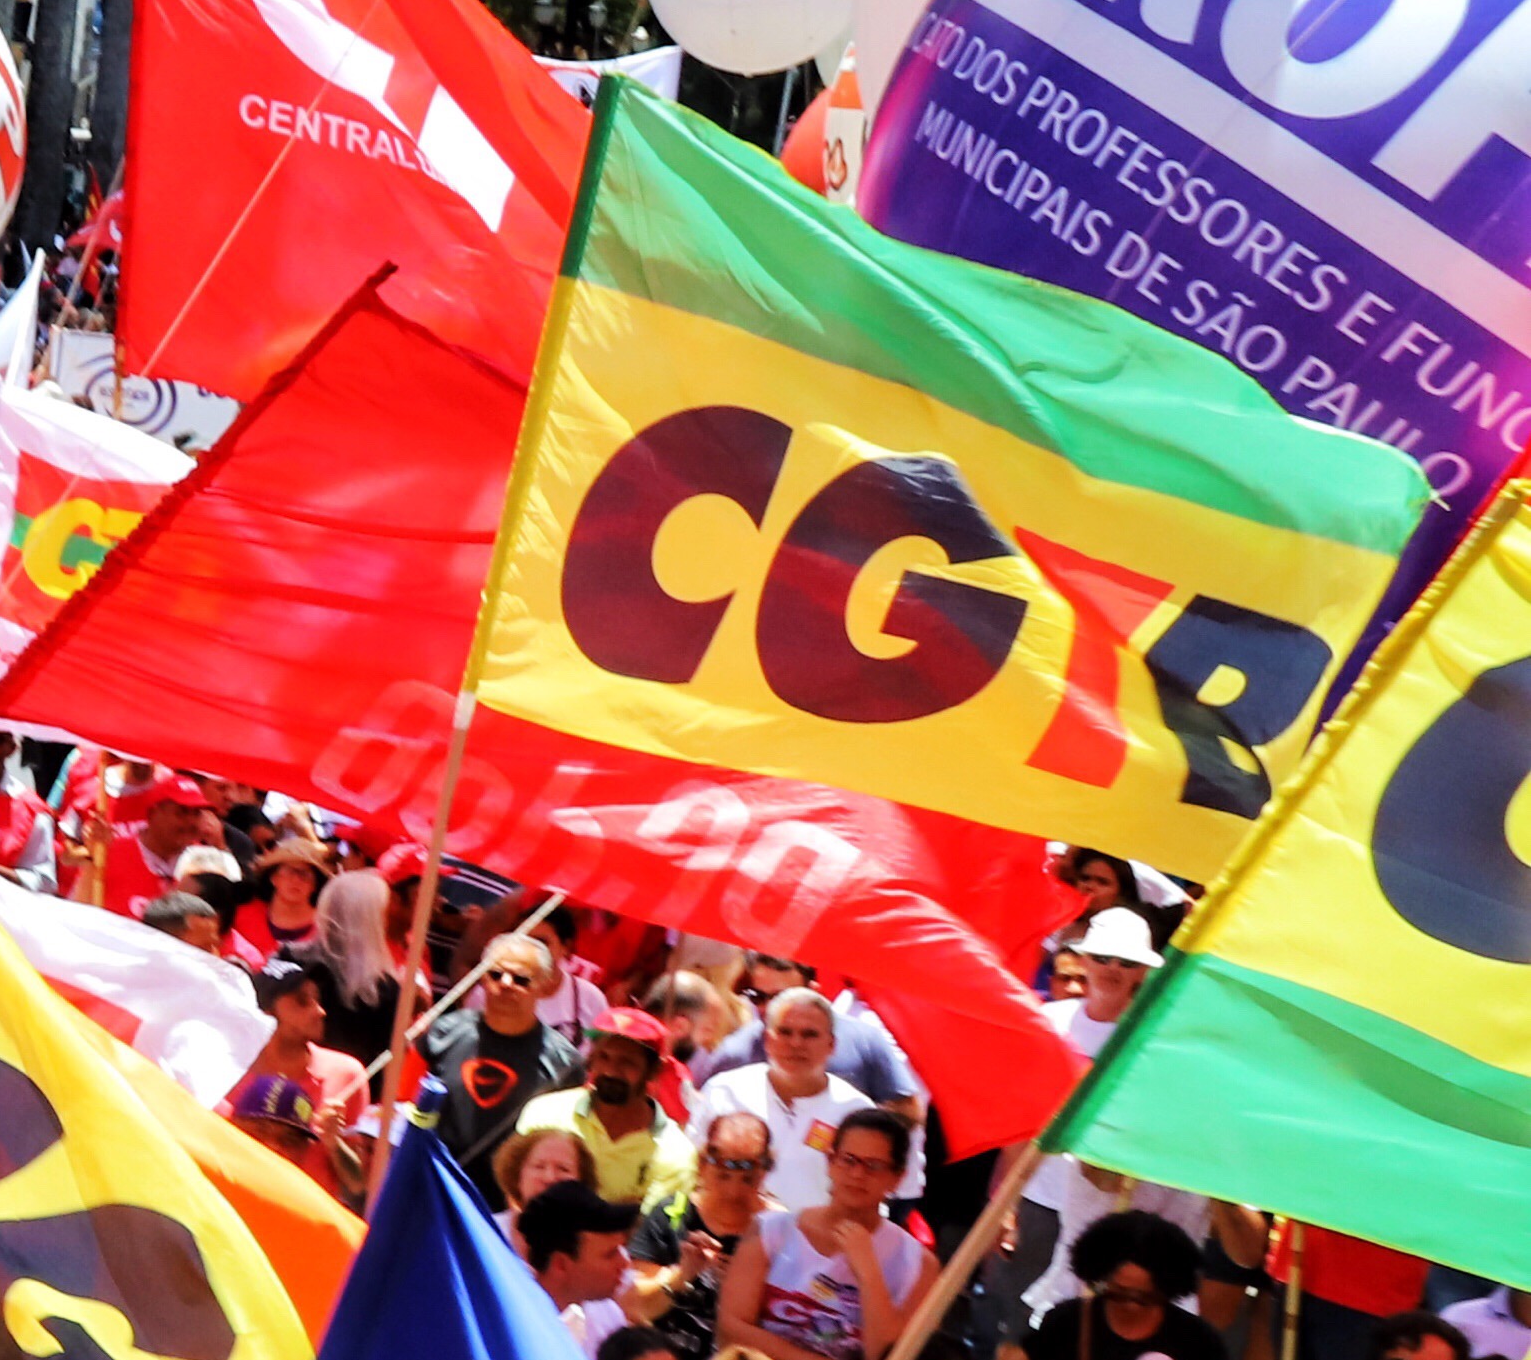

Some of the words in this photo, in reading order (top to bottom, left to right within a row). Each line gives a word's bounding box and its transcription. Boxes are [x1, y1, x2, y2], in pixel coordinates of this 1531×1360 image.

[238, 93, 415, 172] CENTRAL
[913, 100, 1115, 257] MUNICIPAIS
[1106, 228, 1183, 306] DE
[1170, 276, 1288, 374] SÃO
[953, 36, 1030, 106] DOS
[1016, 75, 1346, 314] PROFESSORES
[1334, 290, 1396, 347] E
[561, 403, 1335, 822] CGTB
